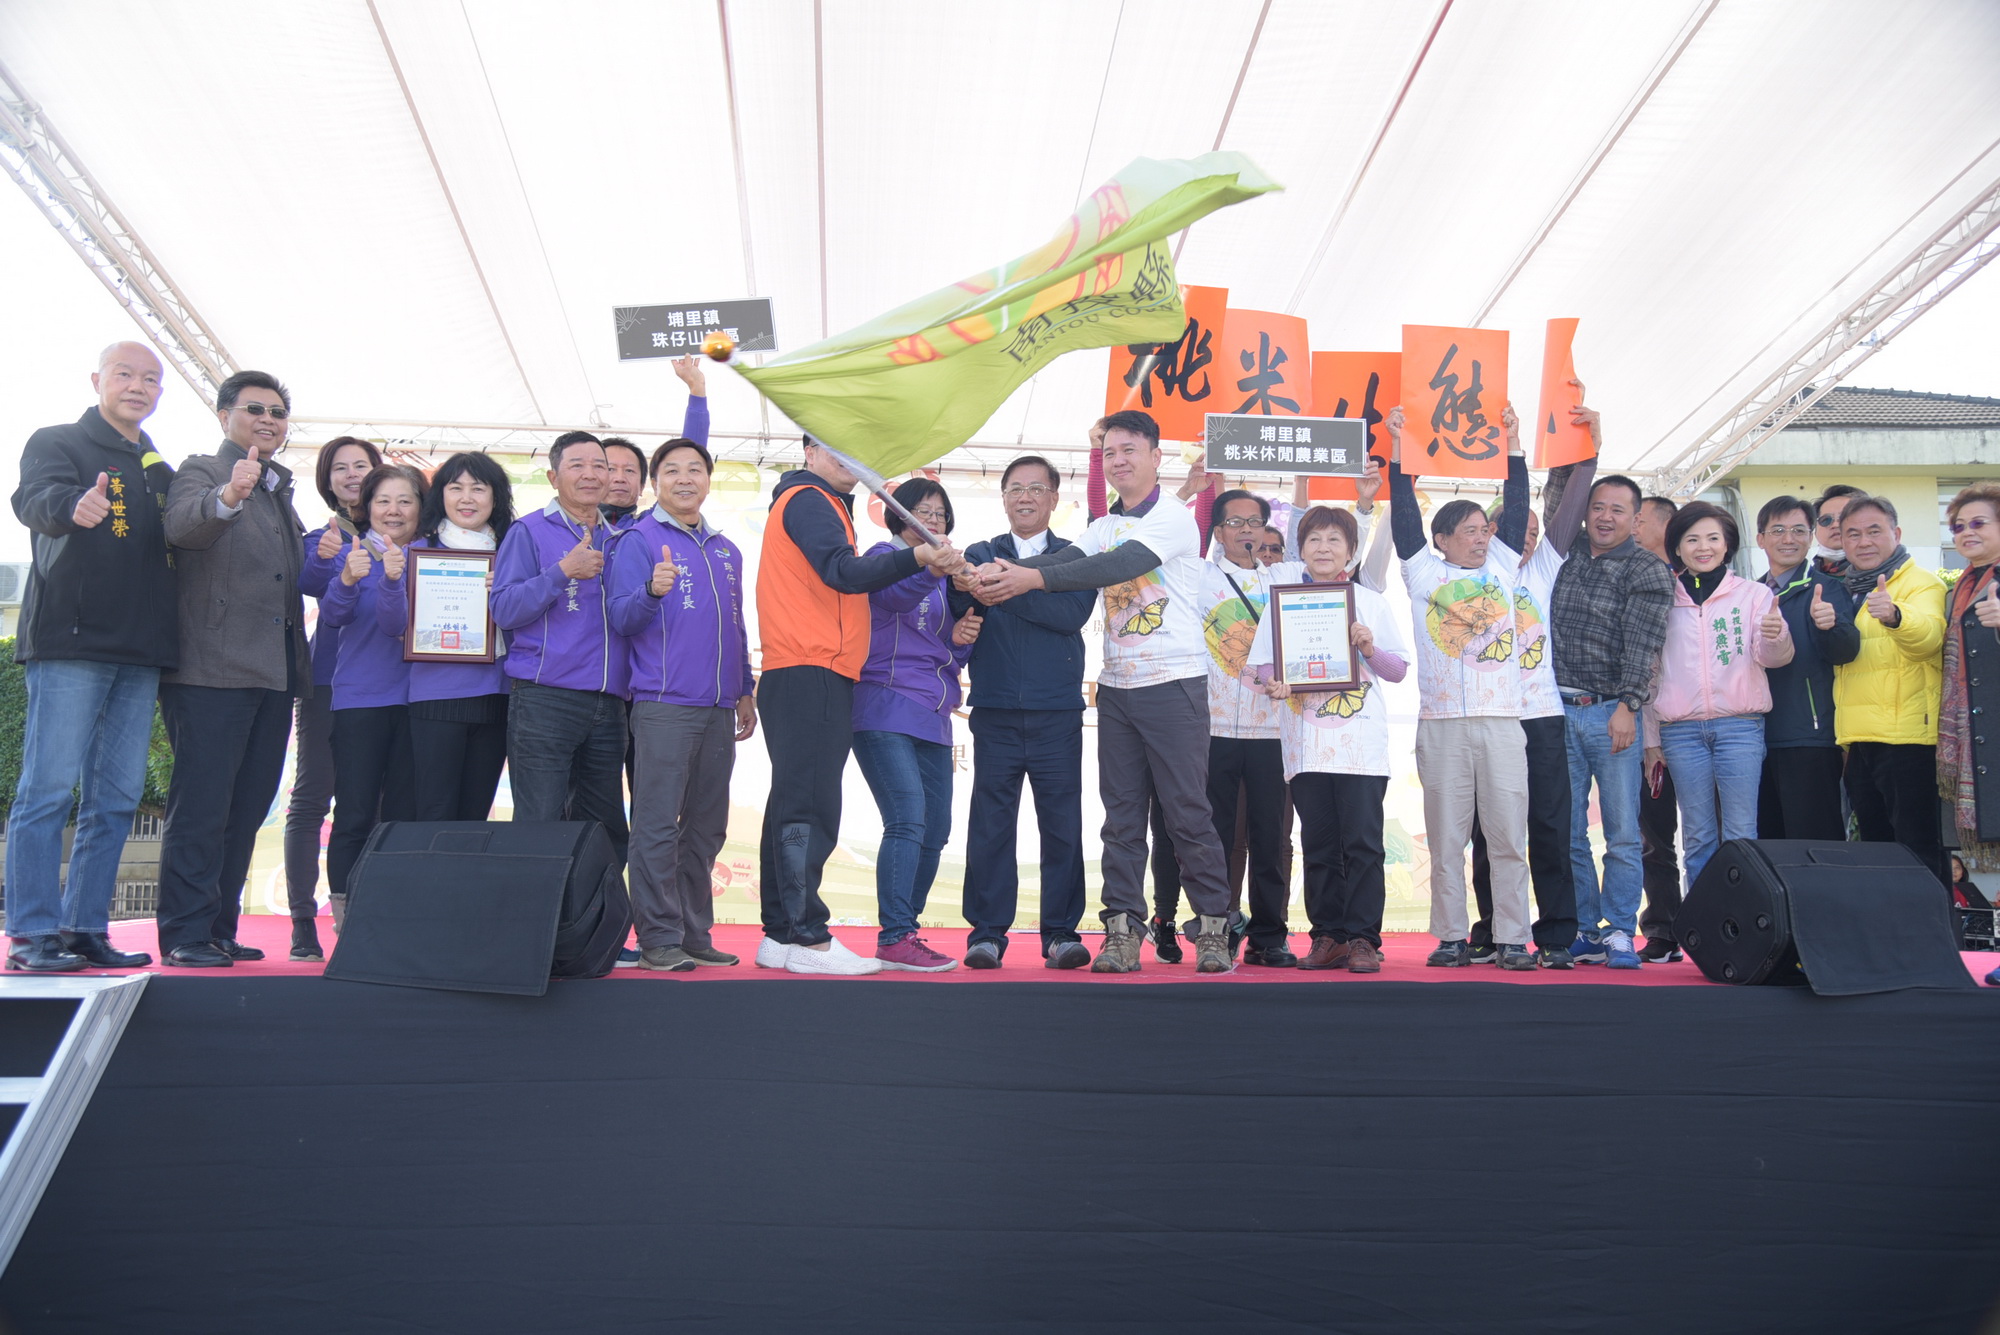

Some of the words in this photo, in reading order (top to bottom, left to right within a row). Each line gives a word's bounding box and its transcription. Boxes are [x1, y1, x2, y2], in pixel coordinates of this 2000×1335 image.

[667, 309, 721, 328] 埔里鎮
[1022, 311, 1101, 367] NANTOU
[1231, 331, 1301, 415] 米
[1426, 342, 1501, 462] 態
[1223, 443, 1348, 464] 桃米休閒農業區
[1259, 425, 1312, 443] 埔里鎮
[109, 477, 130, 538] 黃世榮
[677, 564, 696, 610] 執行長
[917, 596, 931, 631] 事長
[1731, 607, 1744, 656] 南投縣議員
[1712, 617, 1732, 666] 賴燕雪
